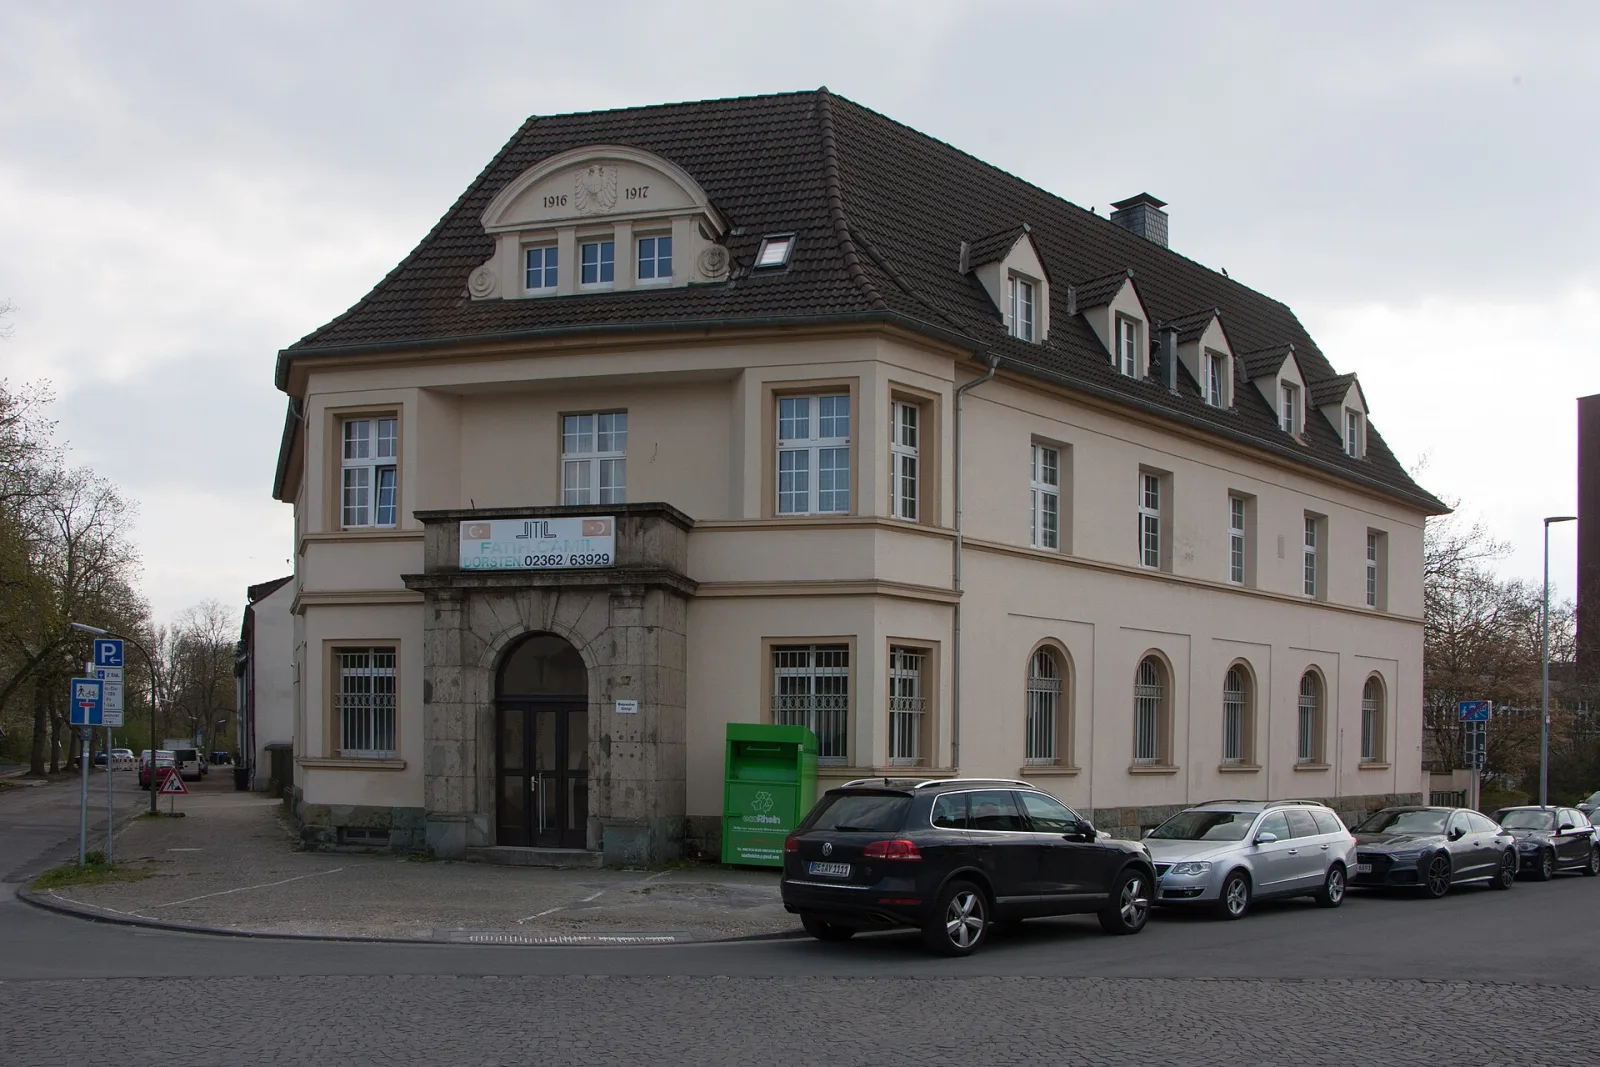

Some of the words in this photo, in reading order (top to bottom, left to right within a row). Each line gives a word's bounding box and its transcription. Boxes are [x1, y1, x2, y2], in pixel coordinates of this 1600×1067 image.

[543, 194, 568, 208] 1916
[625, 186, 649, 200] 1917
[524, 553, 610, 567] 02362/63929
[101, 643, 116, 664] P
